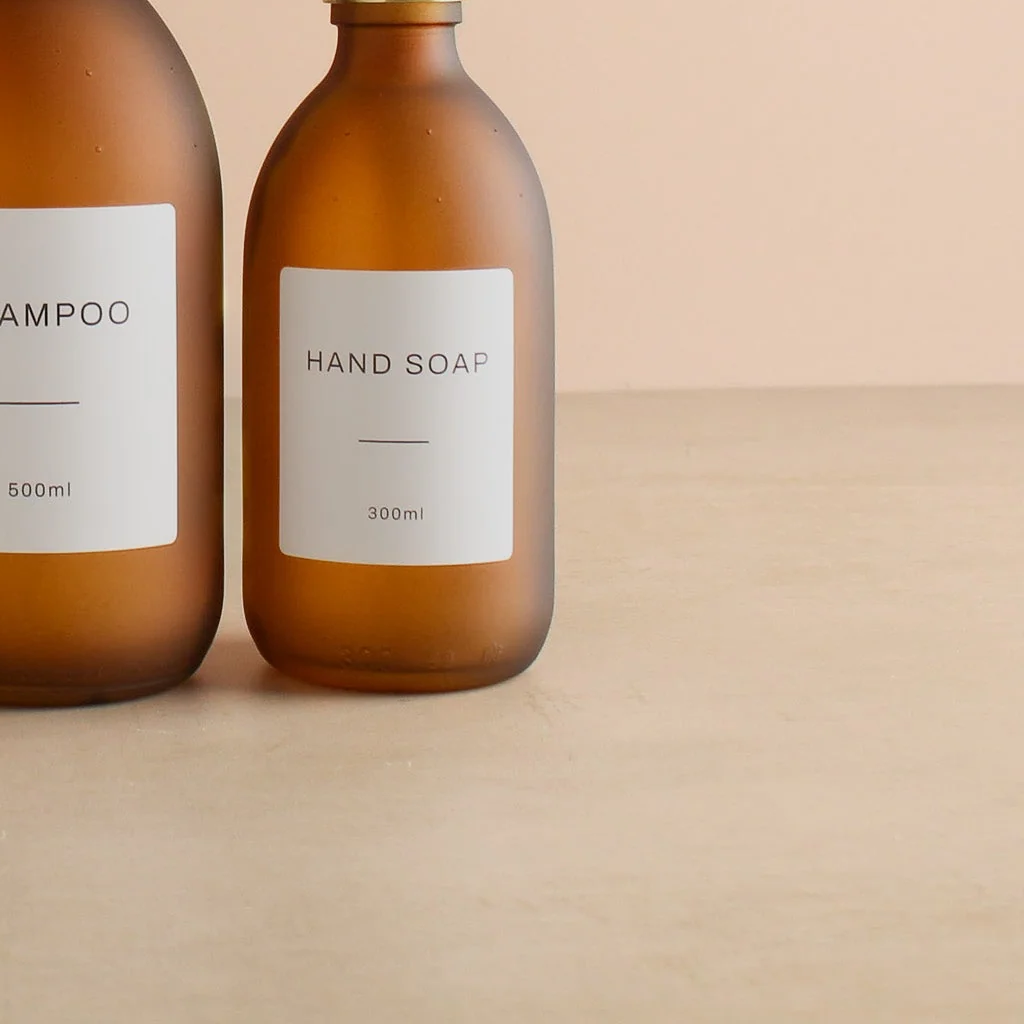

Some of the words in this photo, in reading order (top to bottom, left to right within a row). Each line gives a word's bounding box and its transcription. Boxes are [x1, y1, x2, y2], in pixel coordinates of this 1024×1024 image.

[306, 349, 392, 376] HAND
[406, 351, 489, 376] SOAP
[8, 480, 72, 498] 500ml
[367, 506, 425, 521] 300ml
